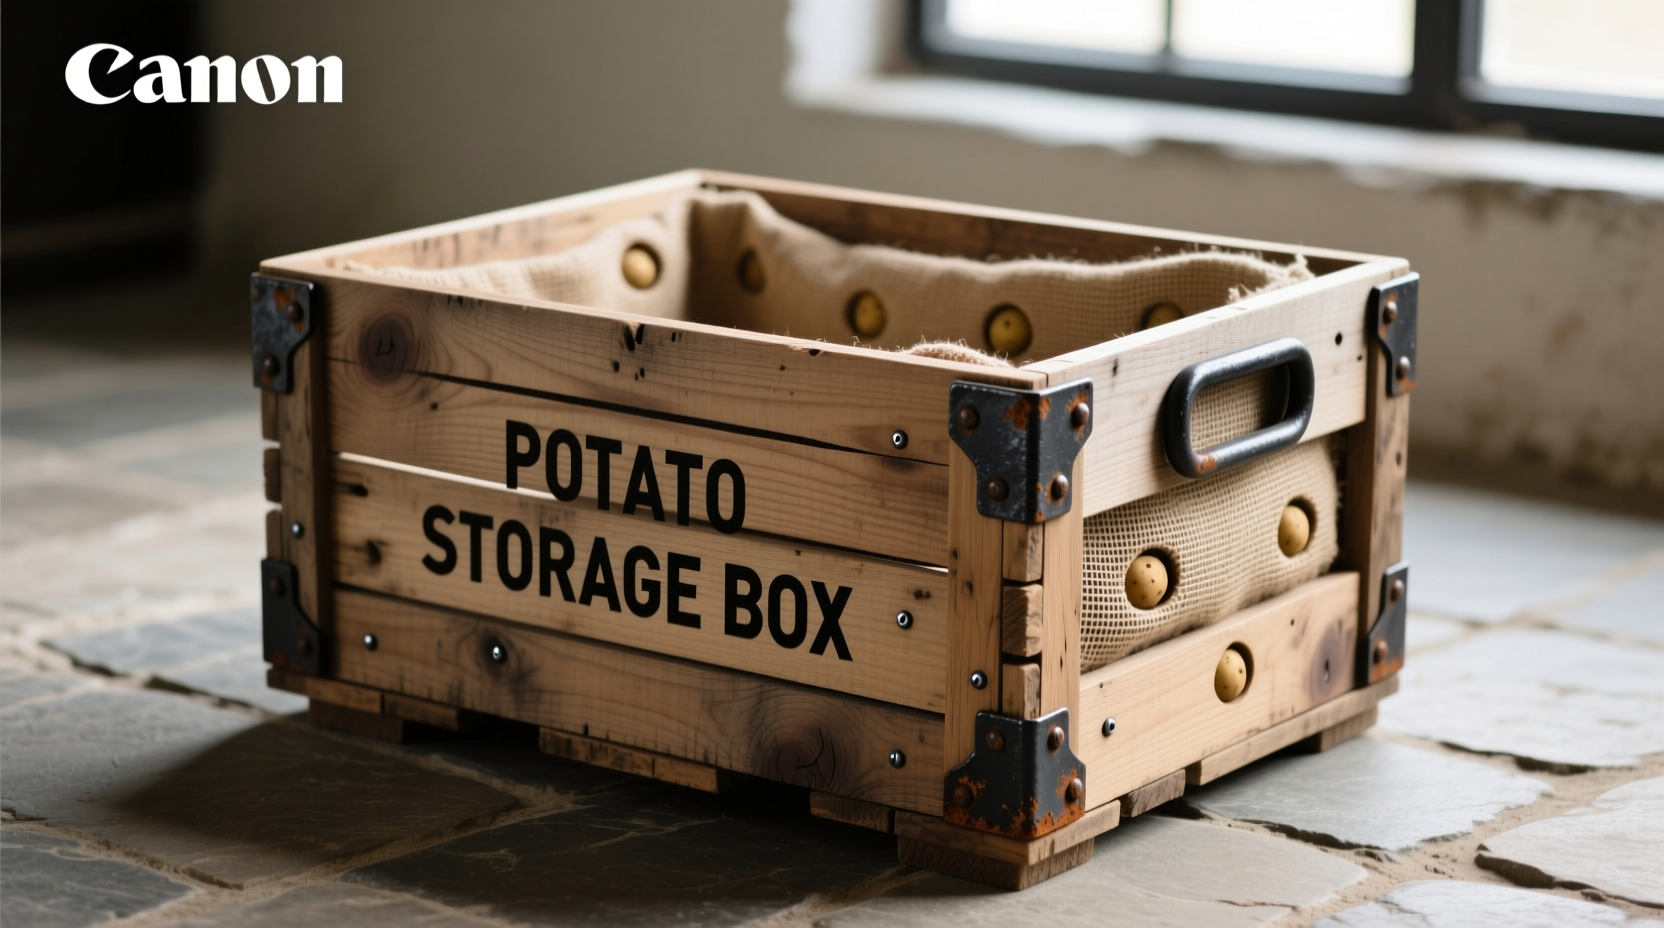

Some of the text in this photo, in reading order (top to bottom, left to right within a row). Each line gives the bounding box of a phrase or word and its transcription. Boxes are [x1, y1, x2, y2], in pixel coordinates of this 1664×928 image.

[505, 420, 747, 535] POTATO
[422, 505, 854, 662] STORAGE BOX
